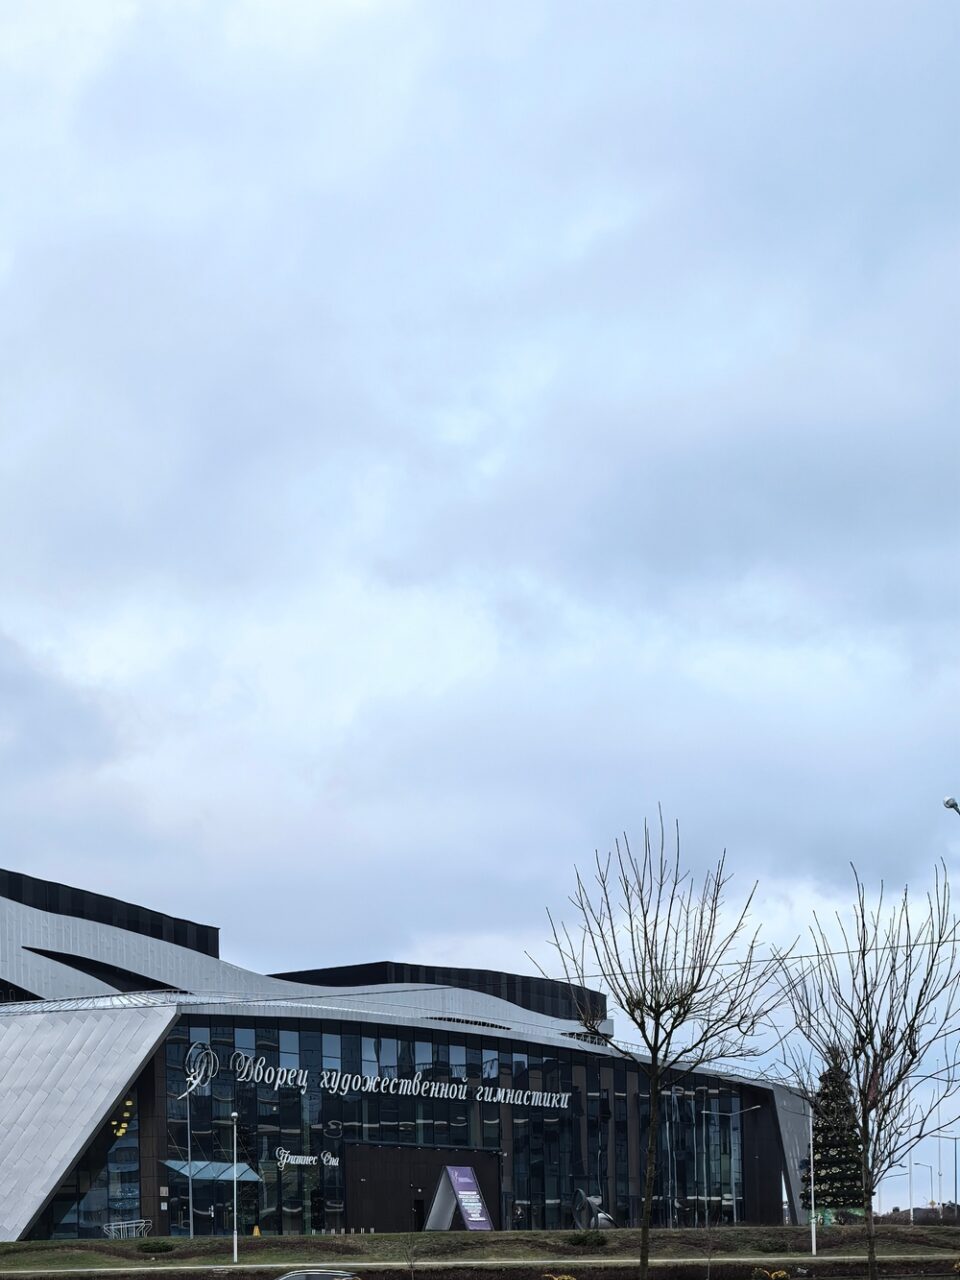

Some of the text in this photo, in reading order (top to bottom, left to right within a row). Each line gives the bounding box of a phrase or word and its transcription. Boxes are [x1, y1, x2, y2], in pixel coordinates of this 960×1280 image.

[229, 1050, 572, 1109] Дворец художественной гимнастики
